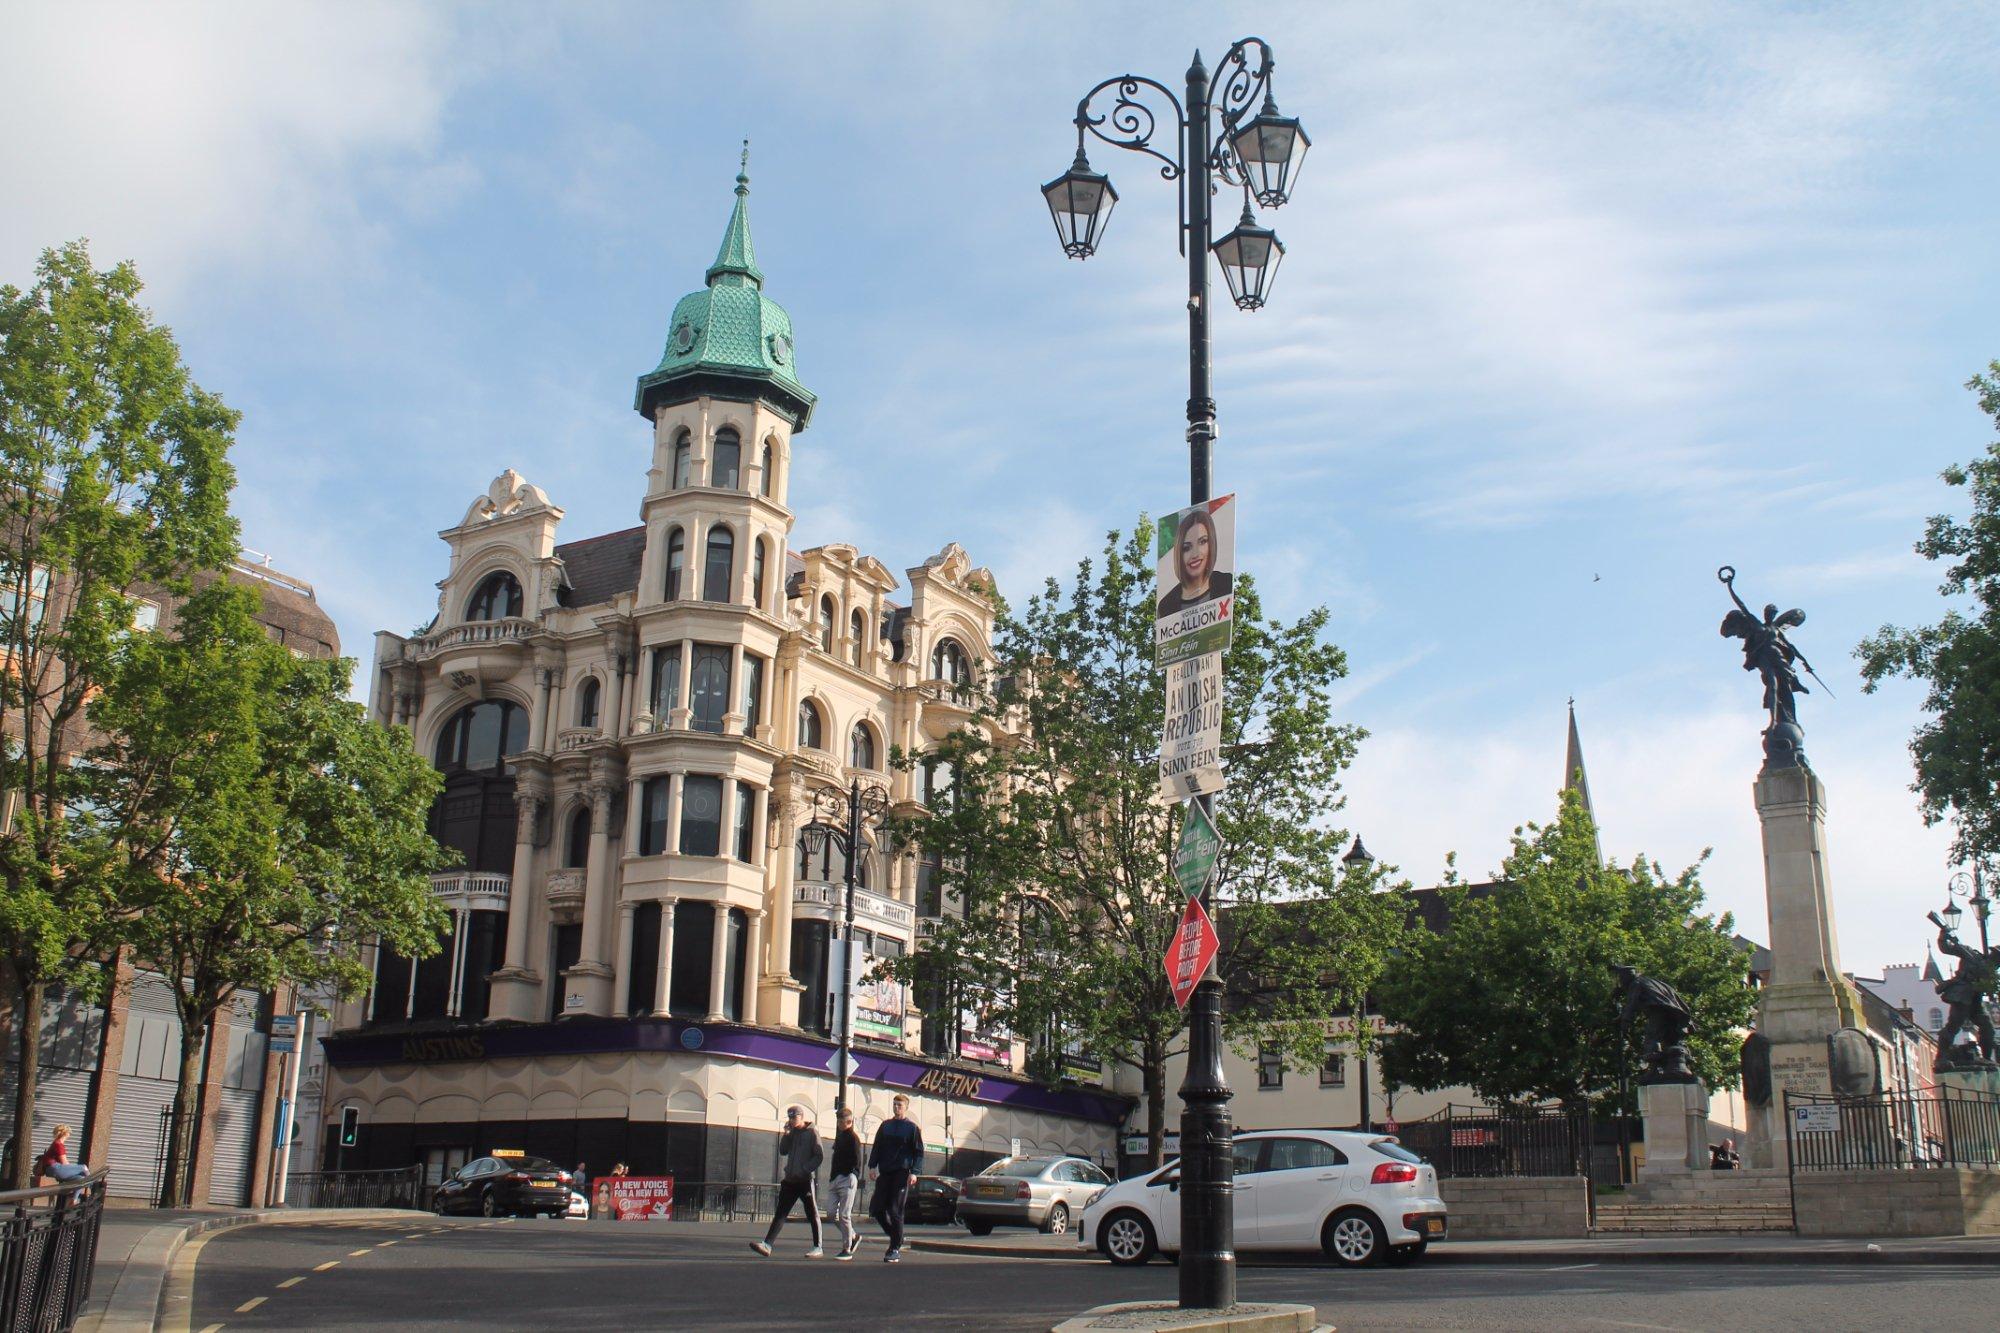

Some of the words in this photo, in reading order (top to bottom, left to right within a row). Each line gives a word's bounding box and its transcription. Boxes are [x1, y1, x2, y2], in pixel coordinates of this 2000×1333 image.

[1160, 610, 1216, 640] McCALLION
[1160, 647, 1178, 660] Sinn
[1172, 661, 1194, 683] REALLY
[1170, 686, 1184, 715] AN
[1188, 675, 1217, 708] IRISH
[1166, 702, 1220, 741] REPUBLIC
[1162, 755, 1188, 778] SINN
[1174, 847, 1193, 868] Sinn
[1181, 919, 1203, 940] PEOPLE
[1178, 938, 1202, 960] BEFORE
[1176, 957, 1199, 979] PROFIT
[402, 1035, 484, 1061] AUSTINS
[1138, 1142, 1176, 1150] Bado's
[614, 1181, 621, 1189] A
[622, 1181, 641, 1189] NEW
[642, 1180, 668, 1189] VOICE
[614, 1189, 628, 1198] FOR
[628, 1189, 634, 1198] A
[635, 1189, 652, 1197] NEW
[653, 1188, 669, 1197] ERA
